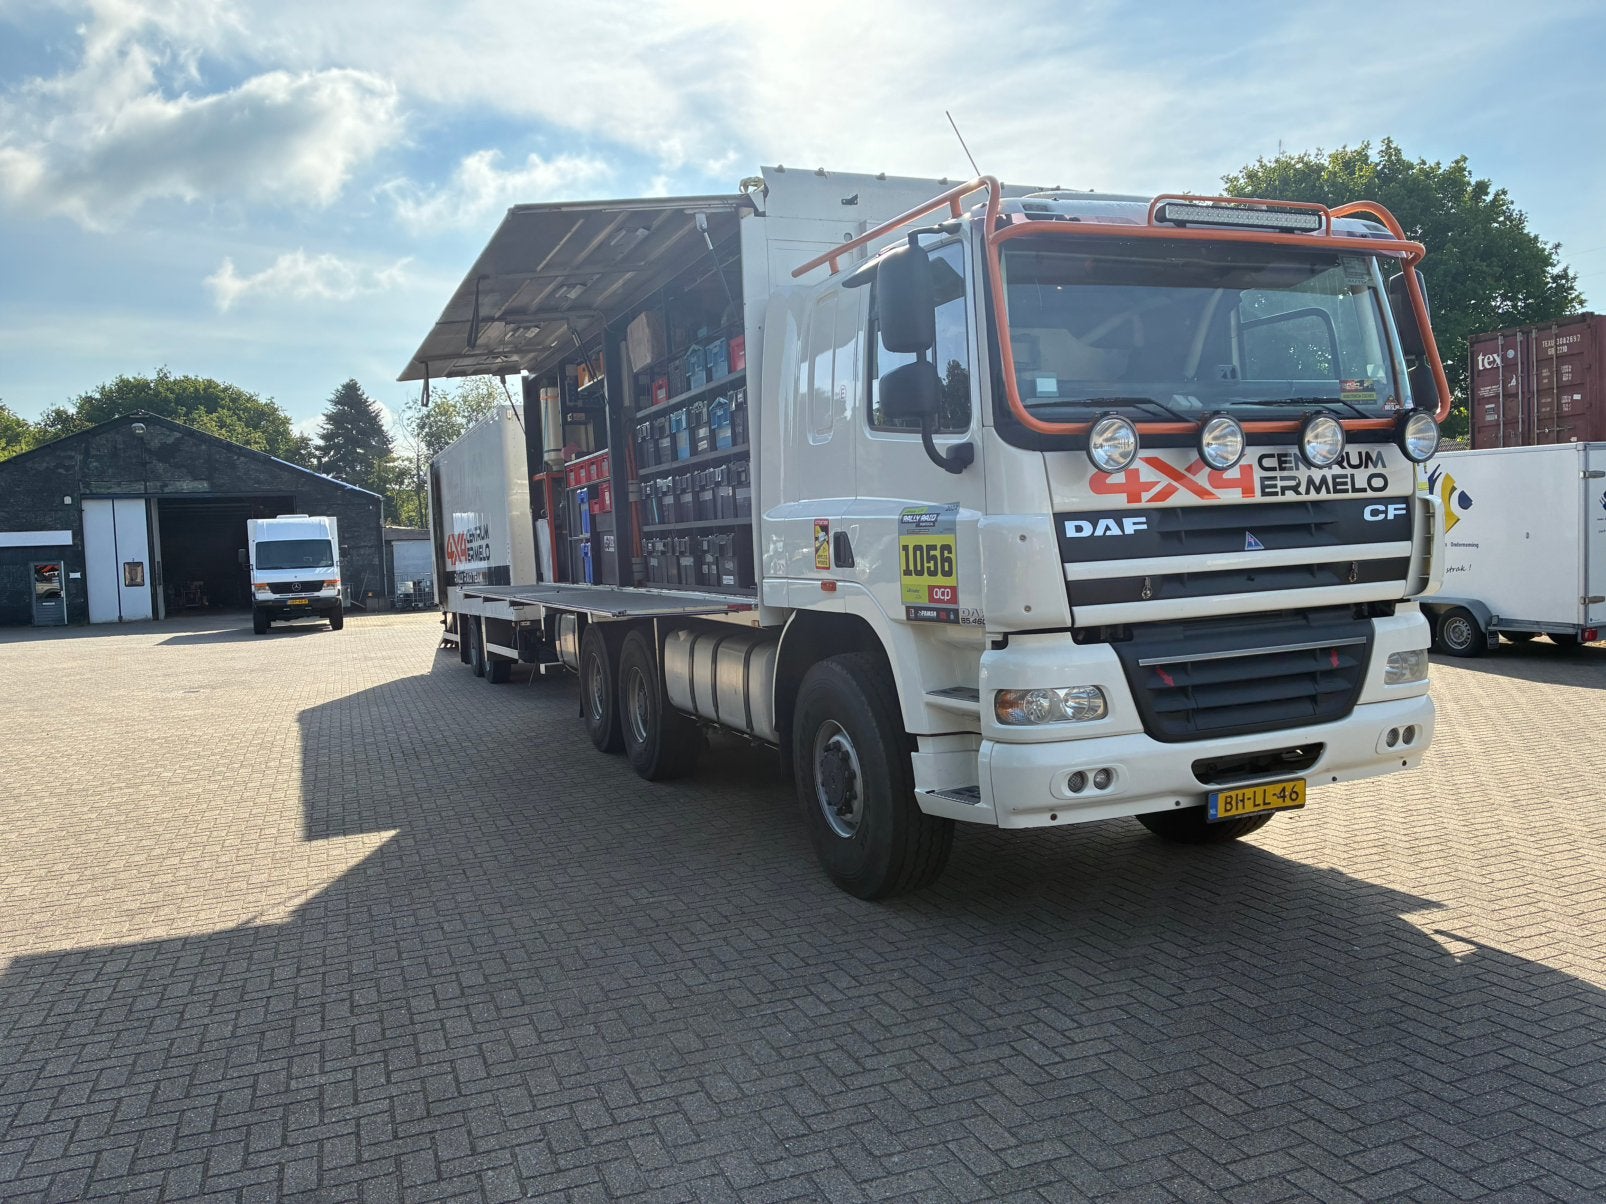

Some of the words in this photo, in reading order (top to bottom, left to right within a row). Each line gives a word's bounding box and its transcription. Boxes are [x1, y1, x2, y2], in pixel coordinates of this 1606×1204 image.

[1477, 352, 1504, 370] tex
[1257, 450, 1387, 472] CENRUM
[1259, 472, 1389, 497] ERMELO
[1363, 503, 1407, 521] CF
[466, 524, 490, 544] CENTRUM
[1064, 517, 1148, 538] DAF
[467, 543, 491, 563] ERMELO
[901, 544, 953, 577] 1056
[1224, 784, 1300, 813] BH-LL-46
